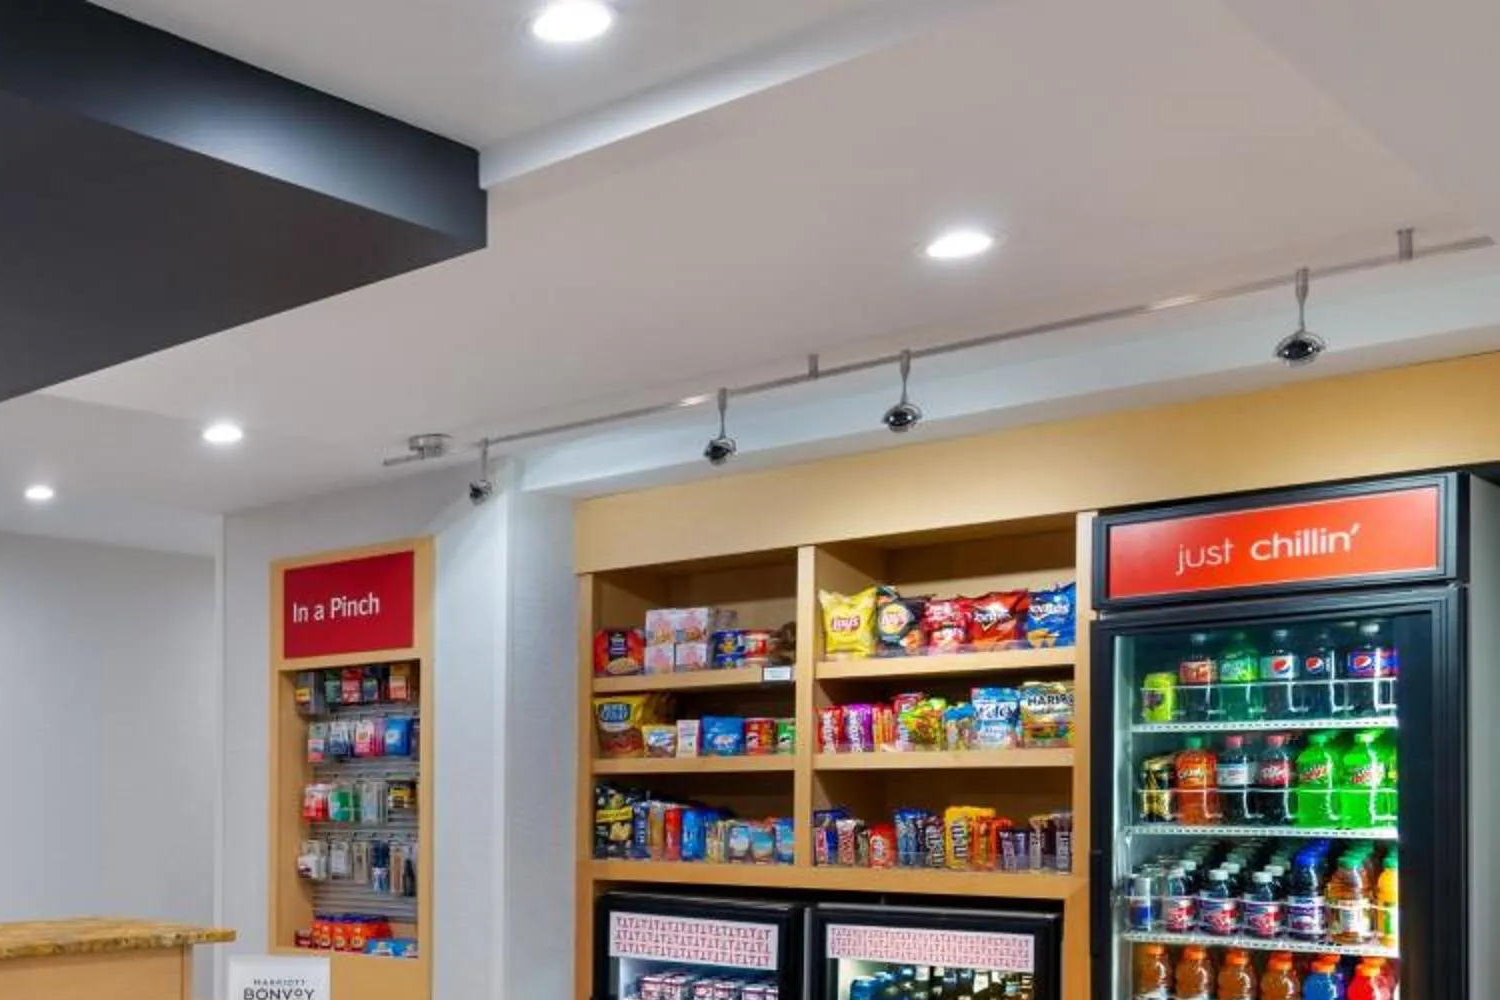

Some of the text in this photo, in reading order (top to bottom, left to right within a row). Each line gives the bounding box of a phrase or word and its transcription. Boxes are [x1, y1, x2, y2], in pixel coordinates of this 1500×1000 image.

[1175, 537, 1234, 576] just
[292, 591, 380, 624] In a Pinch
[243, 988, 315, 1000] BONVOY
